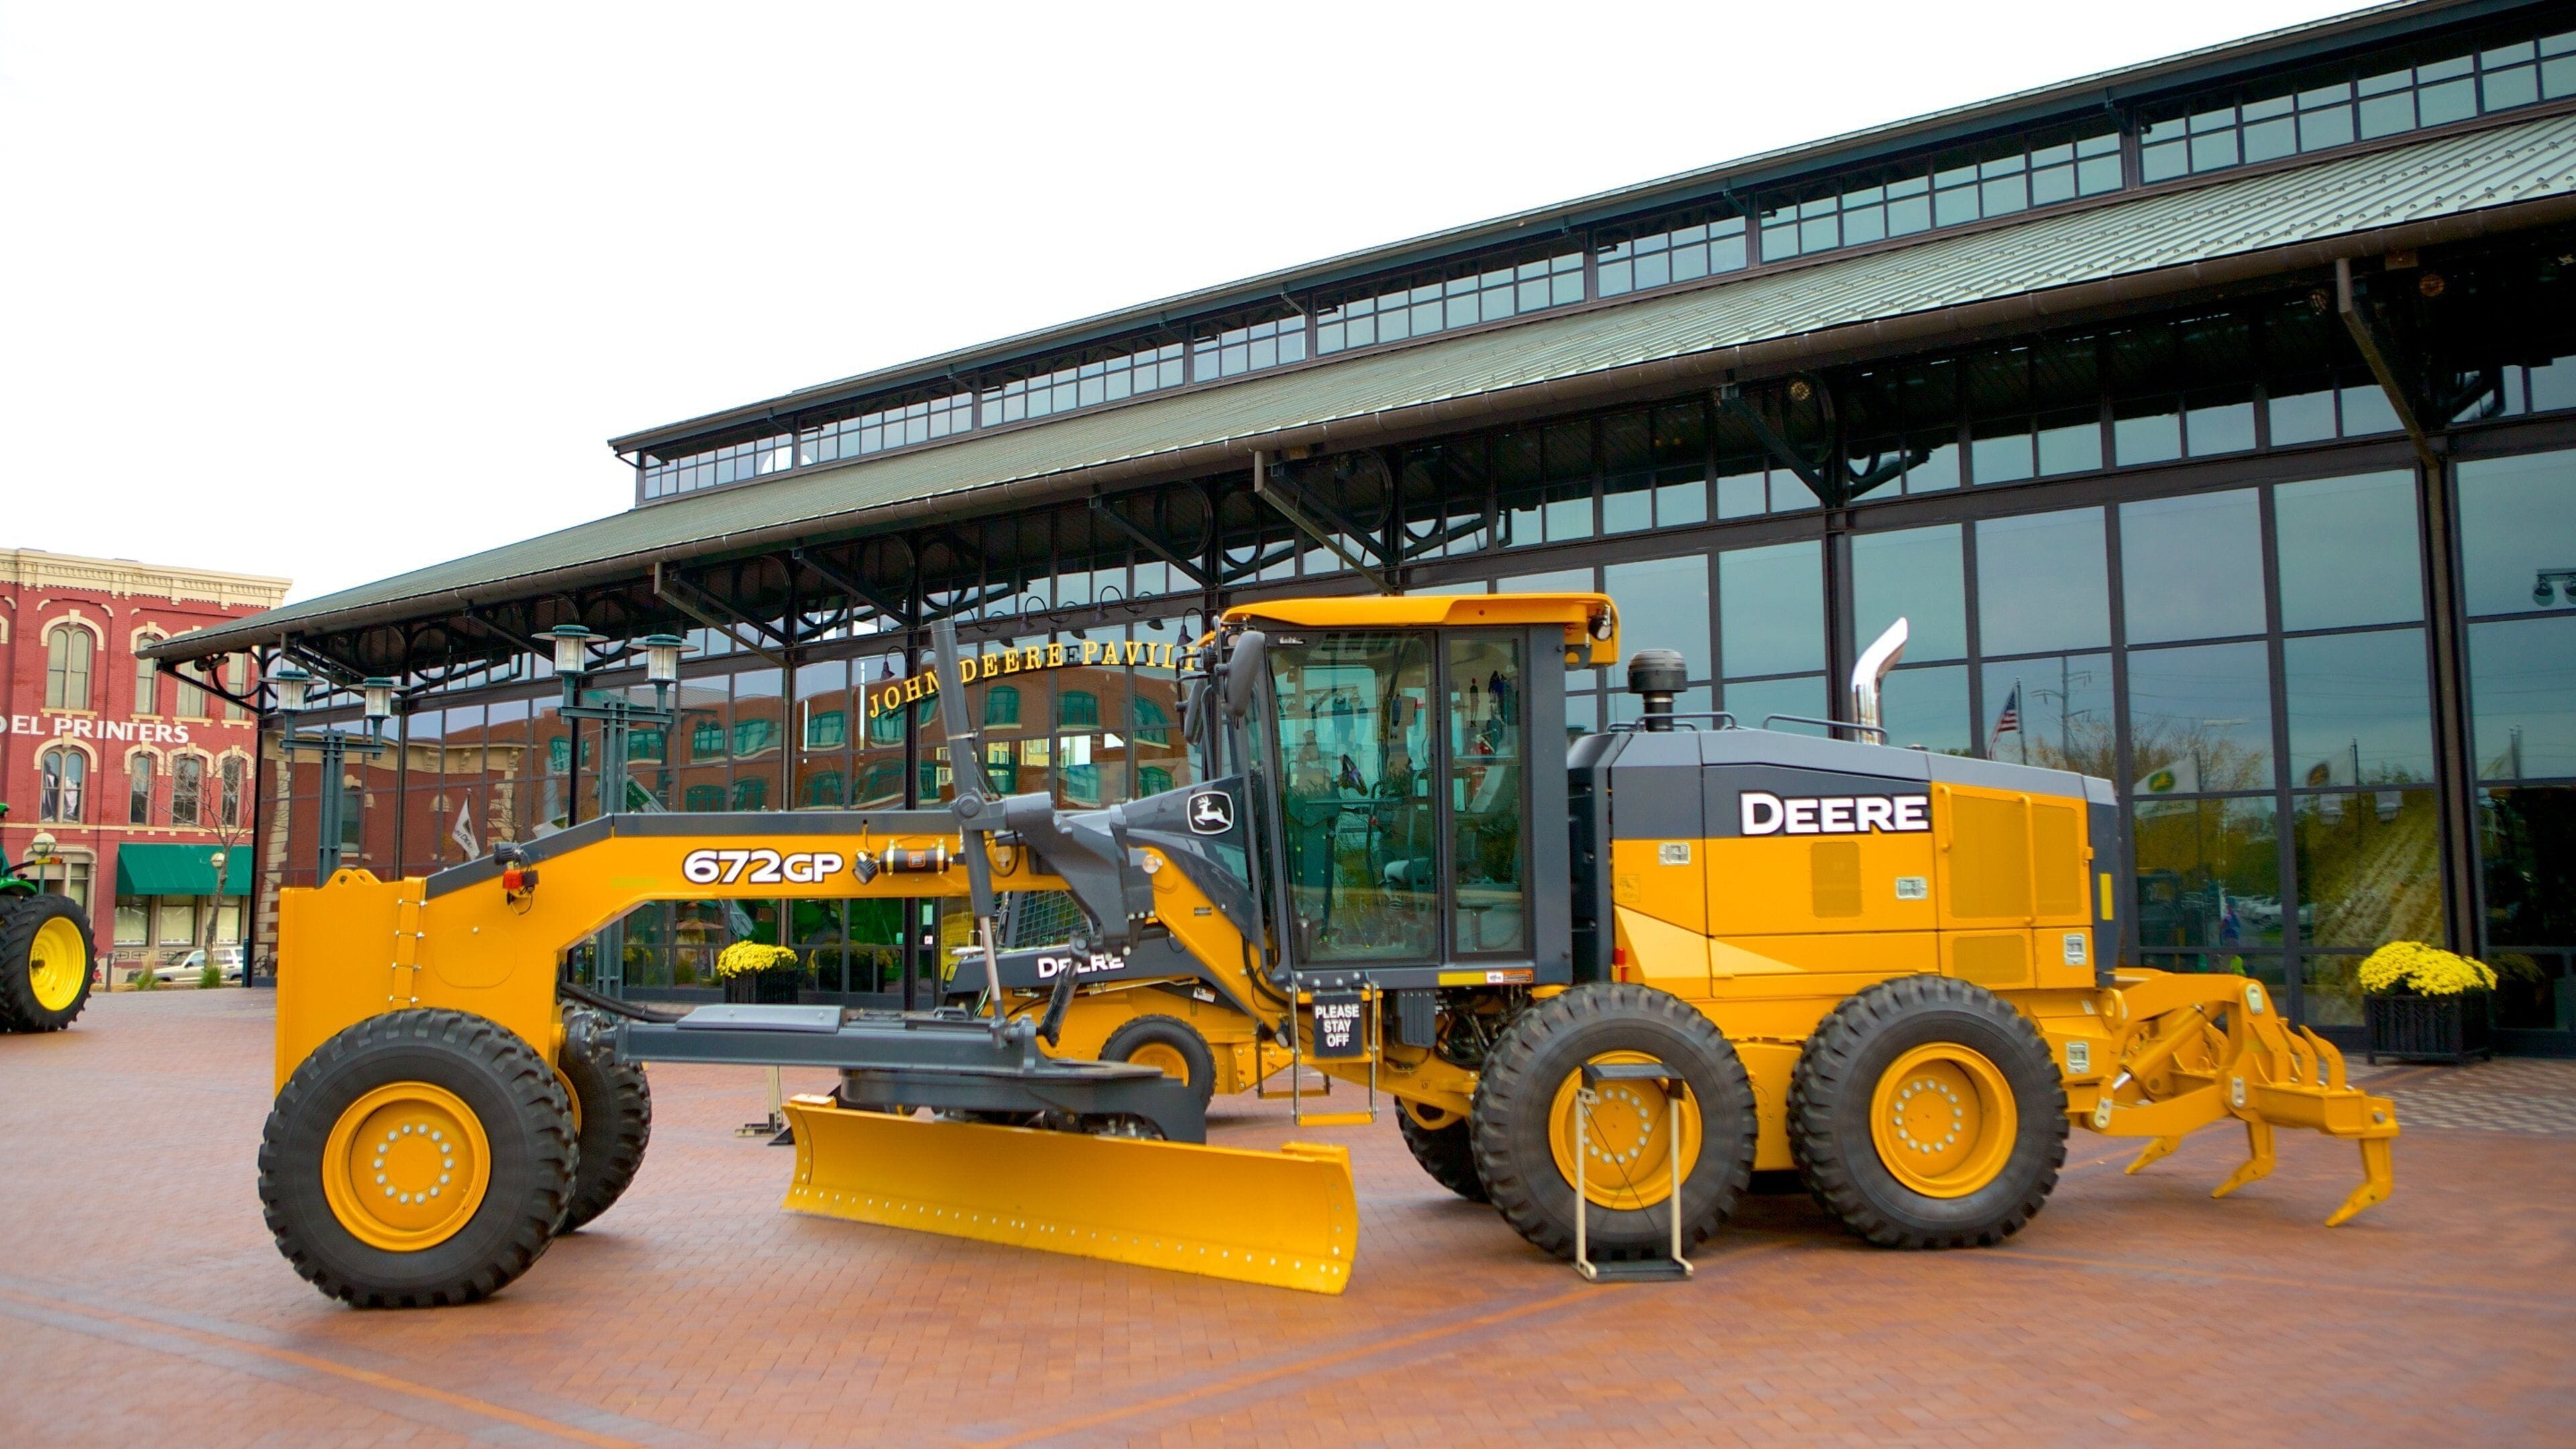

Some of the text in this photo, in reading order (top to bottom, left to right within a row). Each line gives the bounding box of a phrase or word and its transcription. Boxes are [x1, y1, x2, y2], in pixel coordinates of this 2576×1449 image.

[959, 643, 1064, 684] DEERE
[1081, 641, 1197, 671] PAVILI
[54, 717, 190, 744] PRINTERS
[1740, 792, 1930, 835] DEERE
[683, 849, 843, 884] 672GP
[1316, 1004, 1360, 1019] PLEASE
[1324, 1019, 1352, 1033] STAY
[1326, 1033, 1350, 1047] OFF
